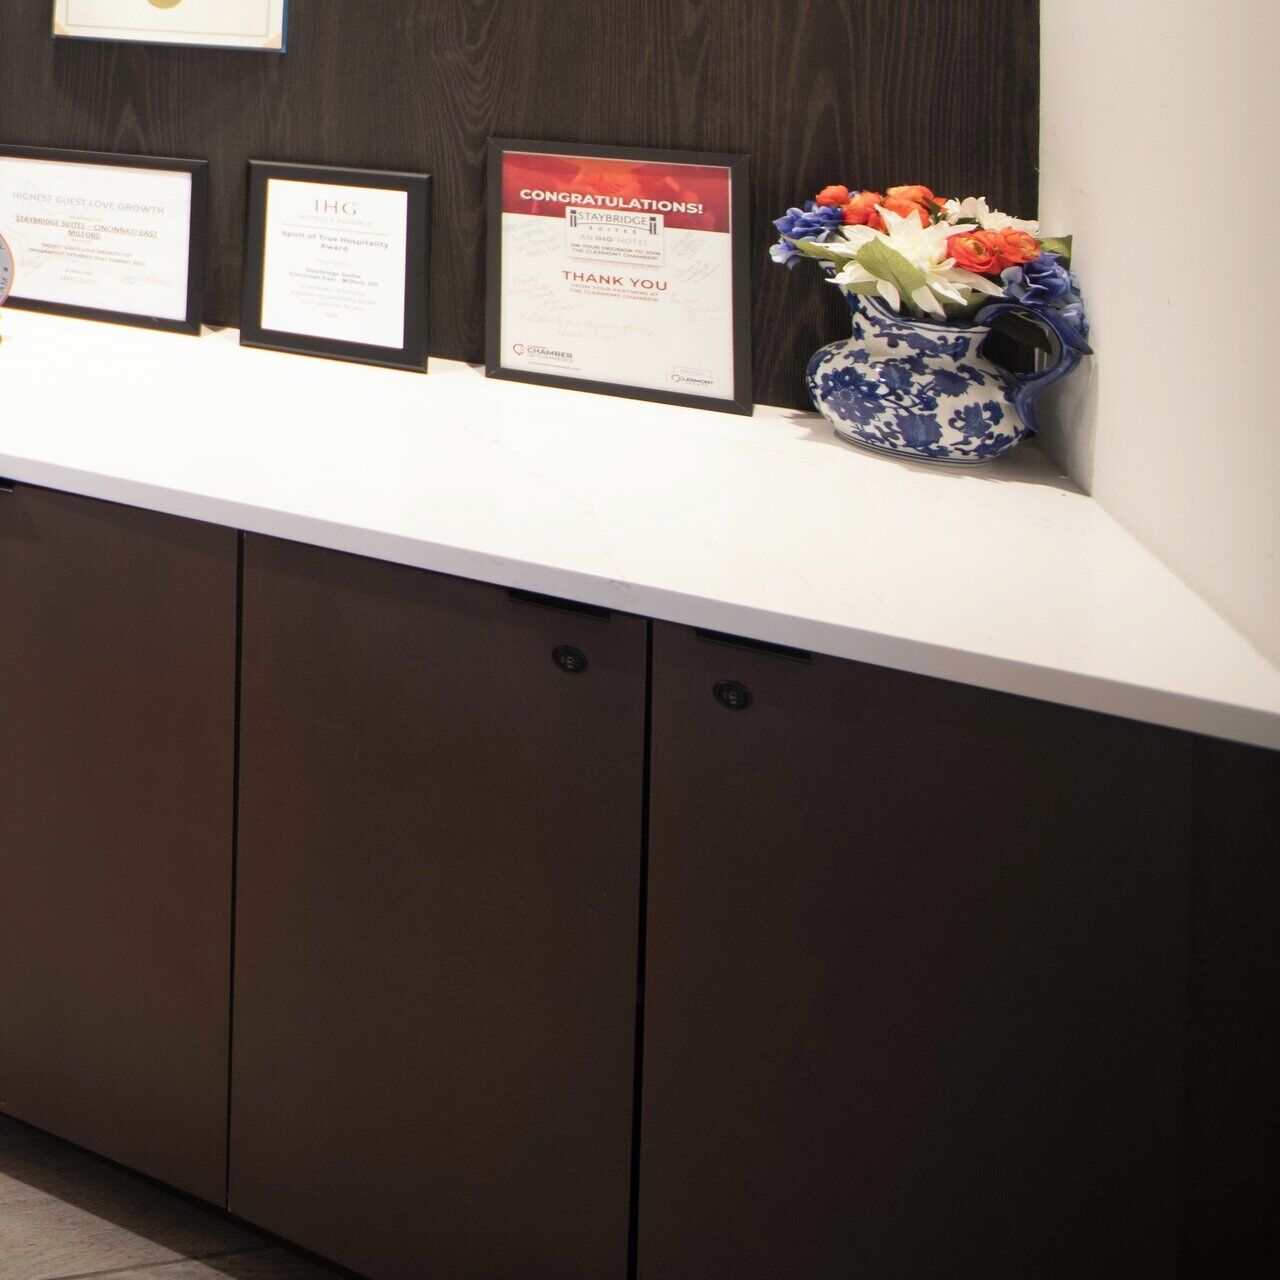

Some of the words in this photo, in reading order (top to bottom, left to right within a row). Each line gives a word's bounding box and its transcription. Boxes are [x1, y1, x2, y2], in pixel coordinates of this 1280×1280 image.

[13, 191, 52, 204] HIGHEST
[55, 195, 86, 207] GUEST
[89, 200, 115, 210] LOVE
[117, 202, 165, 215] GROWTH
[314, 198, 357, 216] IHG
[519, 188, 704, 214] CONGRATULATIONS!
[578, 210, 648, 226] STAYBRIDGE
[15, 214, 60, 227] STAYBRIDGE
[61, 221, 86, 230] SUITES
[94, 224, 138, 236] CINCINNATI
[139, 230, 158, 239] EAST
[68, 230, 102, 240] MILFORD
[282, 230, 305, 240] Spirit
[318, 234, 339, 243] True
[340, 236, 390, 249] Hospitality
[320, 243, 349, 252] Award
[617, 237, 649, 246] HOTEL
[585, 248, 621, 258] CLERMONT
[603, 245, 634, 254] DECISION
[644, 249, 661, 257] JOIN
[561, 270, 626, 287] THANK
[629, 277, 668, 291] YOU
[583, 289, 621, 299] CLERMONT
[612, 286, 647, 296] PARTNERS
[527, 347, 574, 359] CHAMBER
